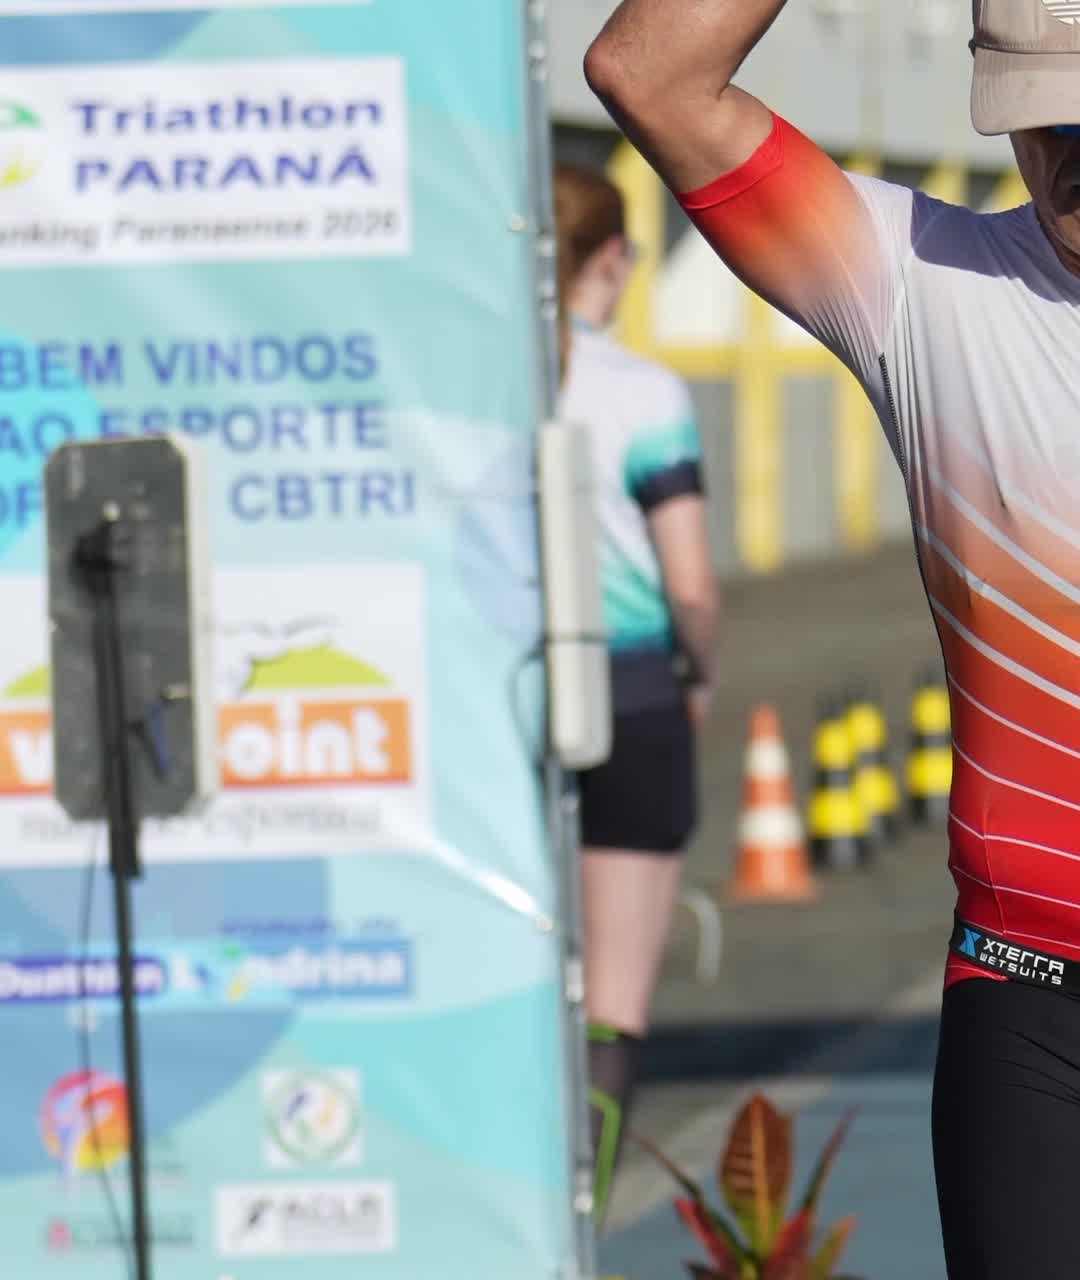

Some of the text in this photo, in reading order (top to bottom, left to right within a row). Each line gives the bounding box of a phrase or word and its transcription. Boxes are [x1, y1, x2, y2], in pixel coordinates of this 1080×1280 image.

[72, 96, 384, 135] Triathlon
[75, 146, 376, 192] PARANÁ
[0, 333, 378, 392] BEM VINDOS
[230, 472, 415, 523] CBTRI
[980, 952, 1062, 985] WETSUITS
[983, 938, 1065, 975] XTERRA
